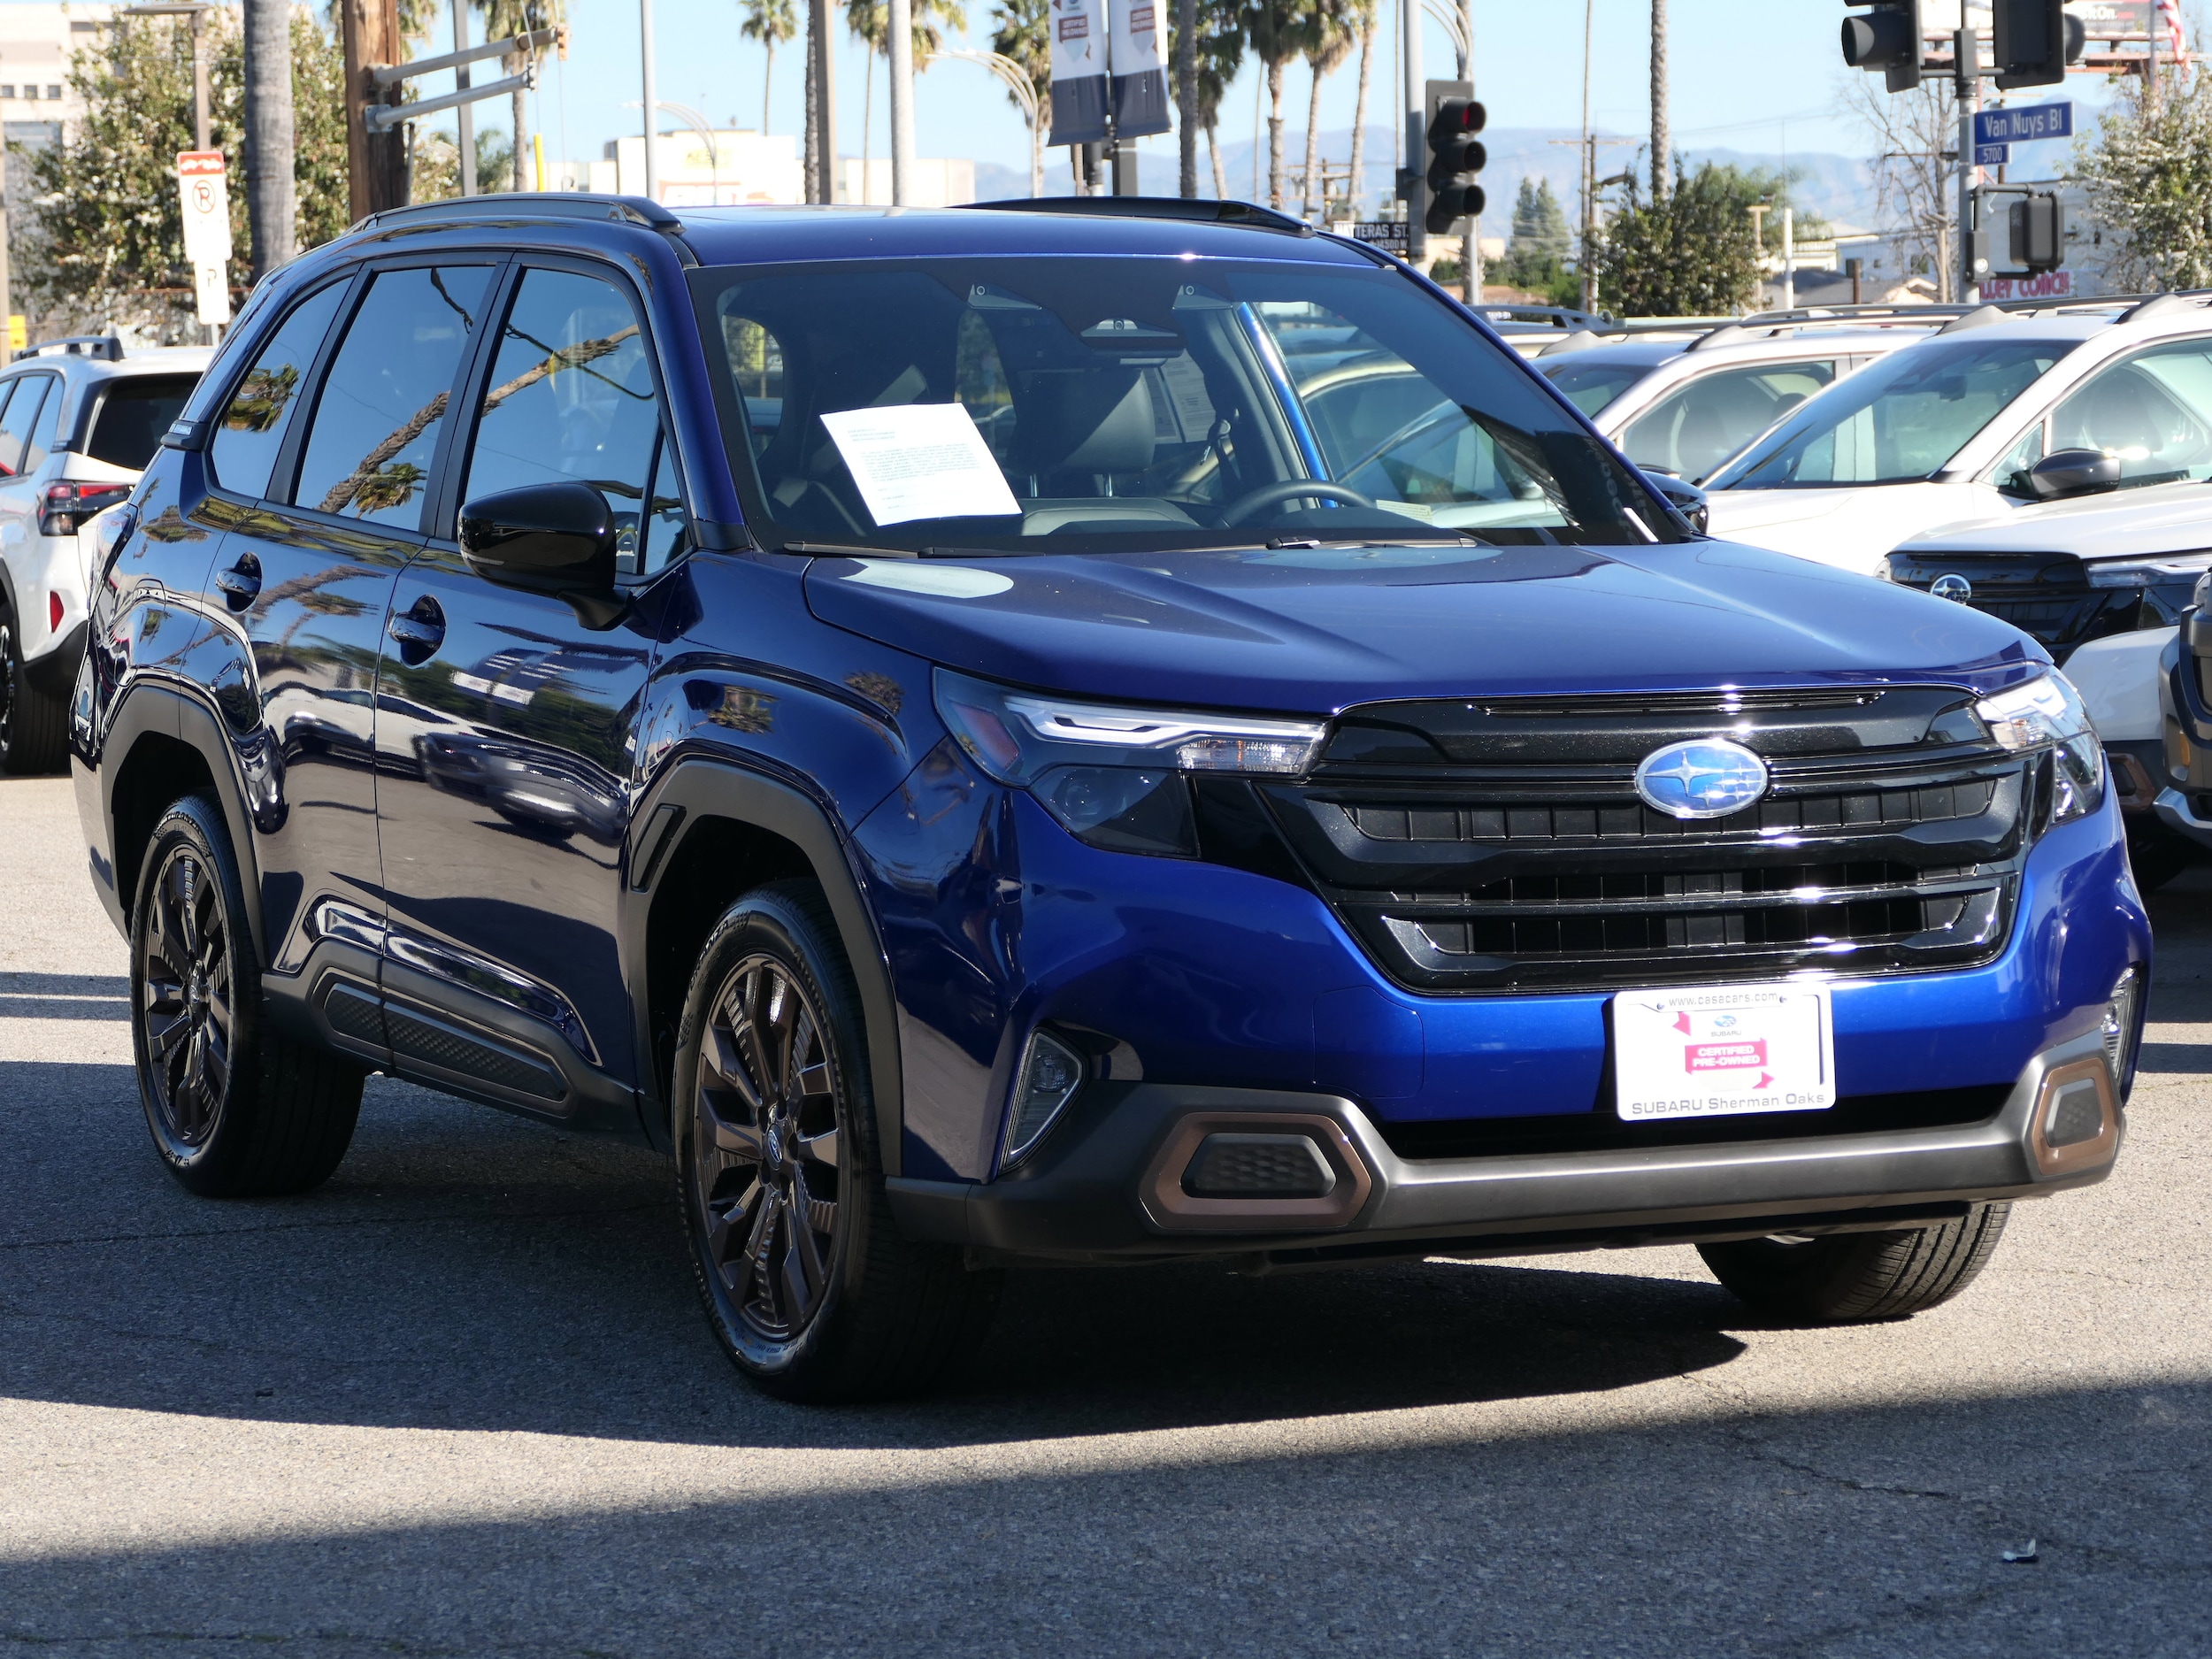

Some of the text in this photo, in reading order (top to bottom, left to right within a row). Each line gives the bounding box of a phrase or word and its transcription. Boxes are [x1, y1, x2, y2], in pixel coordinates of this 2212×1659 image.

[1985, 108, 2062, 139] Van Nuys Bl
[1983, 146, 2003, 164] 5700
[1979, 279, 2013, 300] LLEY
[1669, 992, 1778, 1007] www.casacars.com
[1697, 1045, 1755, 1057] CERTIFIED
[1692, 1054, 1761, 1068] PRE-OWNED
[1632, 1092, 1825, 1115] SUBARU Sherman Oaks
